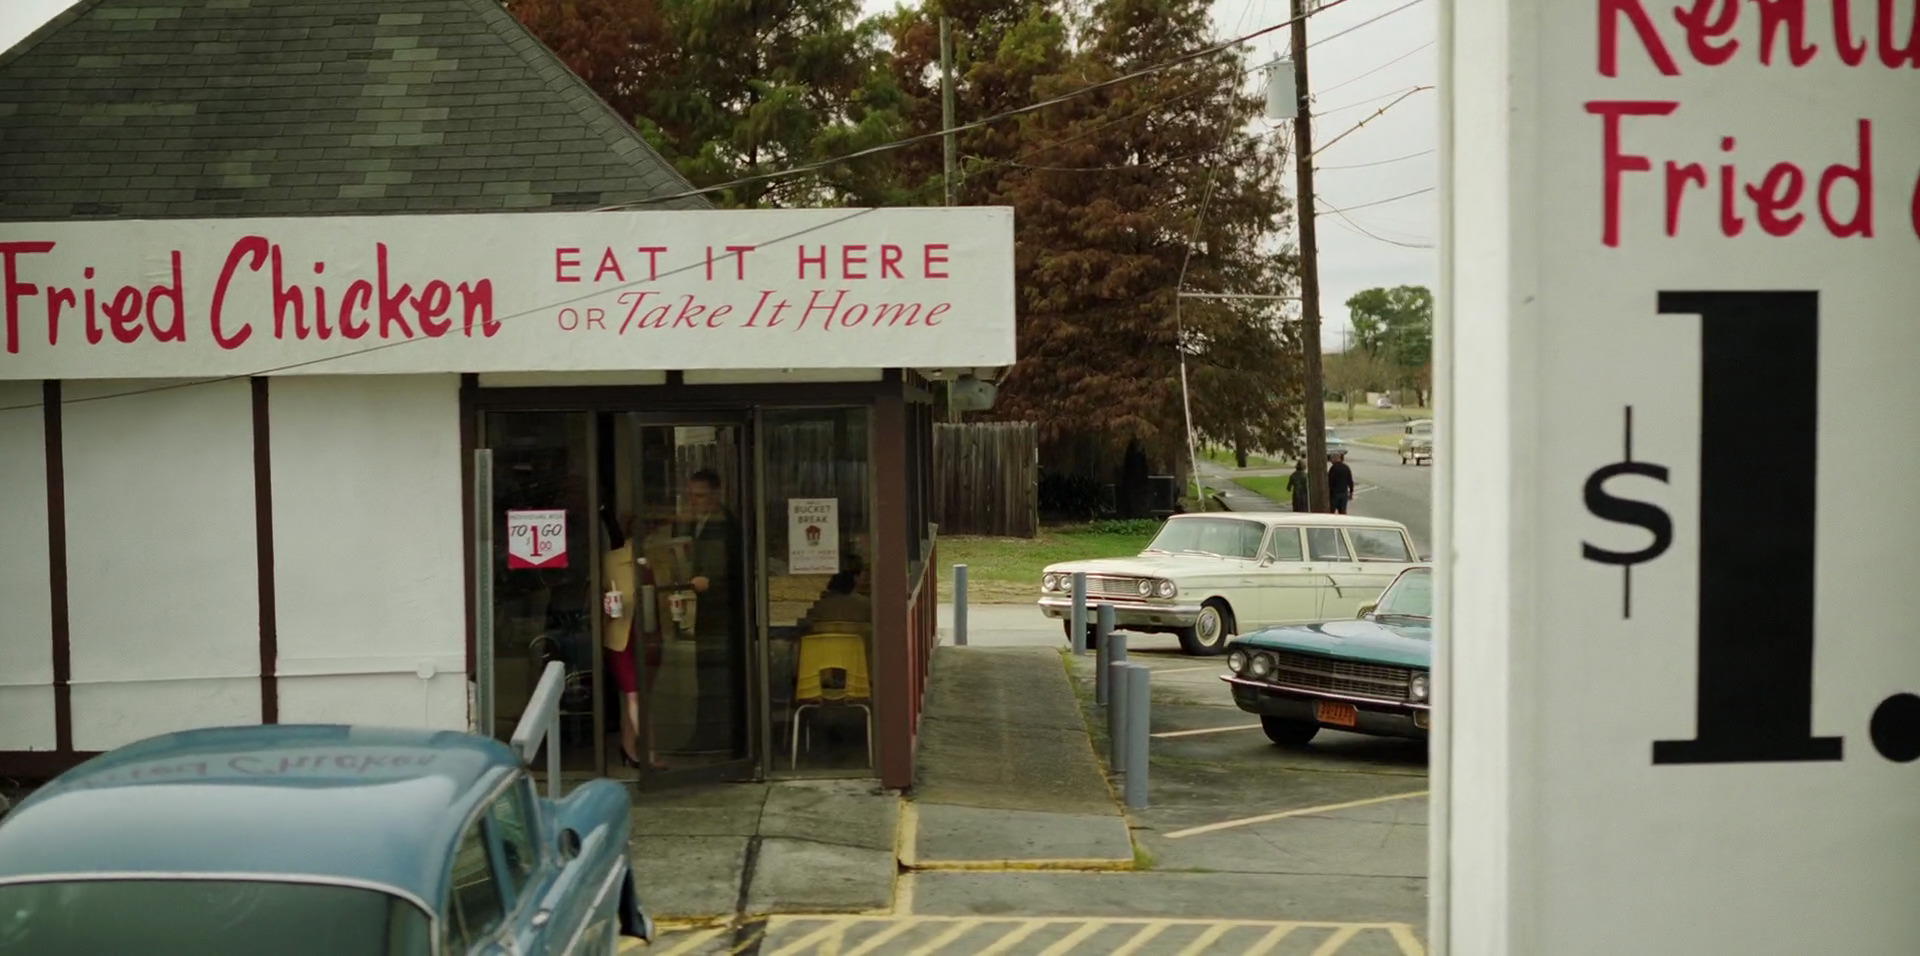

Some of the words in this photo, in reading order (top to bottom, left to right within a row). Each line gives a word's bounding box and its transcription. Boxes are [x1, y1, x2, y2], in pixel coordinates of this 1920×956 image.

[1584, 100, 1876, 249] Fried
[554, 245, 670, 284] EAT
[705, 244, 756, 281] IT
[797, 243, 951, 281] HERE
[0, 241, 187, 353] Fried
[209, 235, 502, 351] Chicken
[557, 307, 606, 331] OR
[616, 291, 733, 335] Take
[739, 289, 793, 329] It
[792, 289, 952, 333] Home
[510, 524, 528, 537] TO
[541, 523, 563, 537] GO
[793, 505, 831, 514] BUCKET
[797, 515, 828, 524] BREAK
